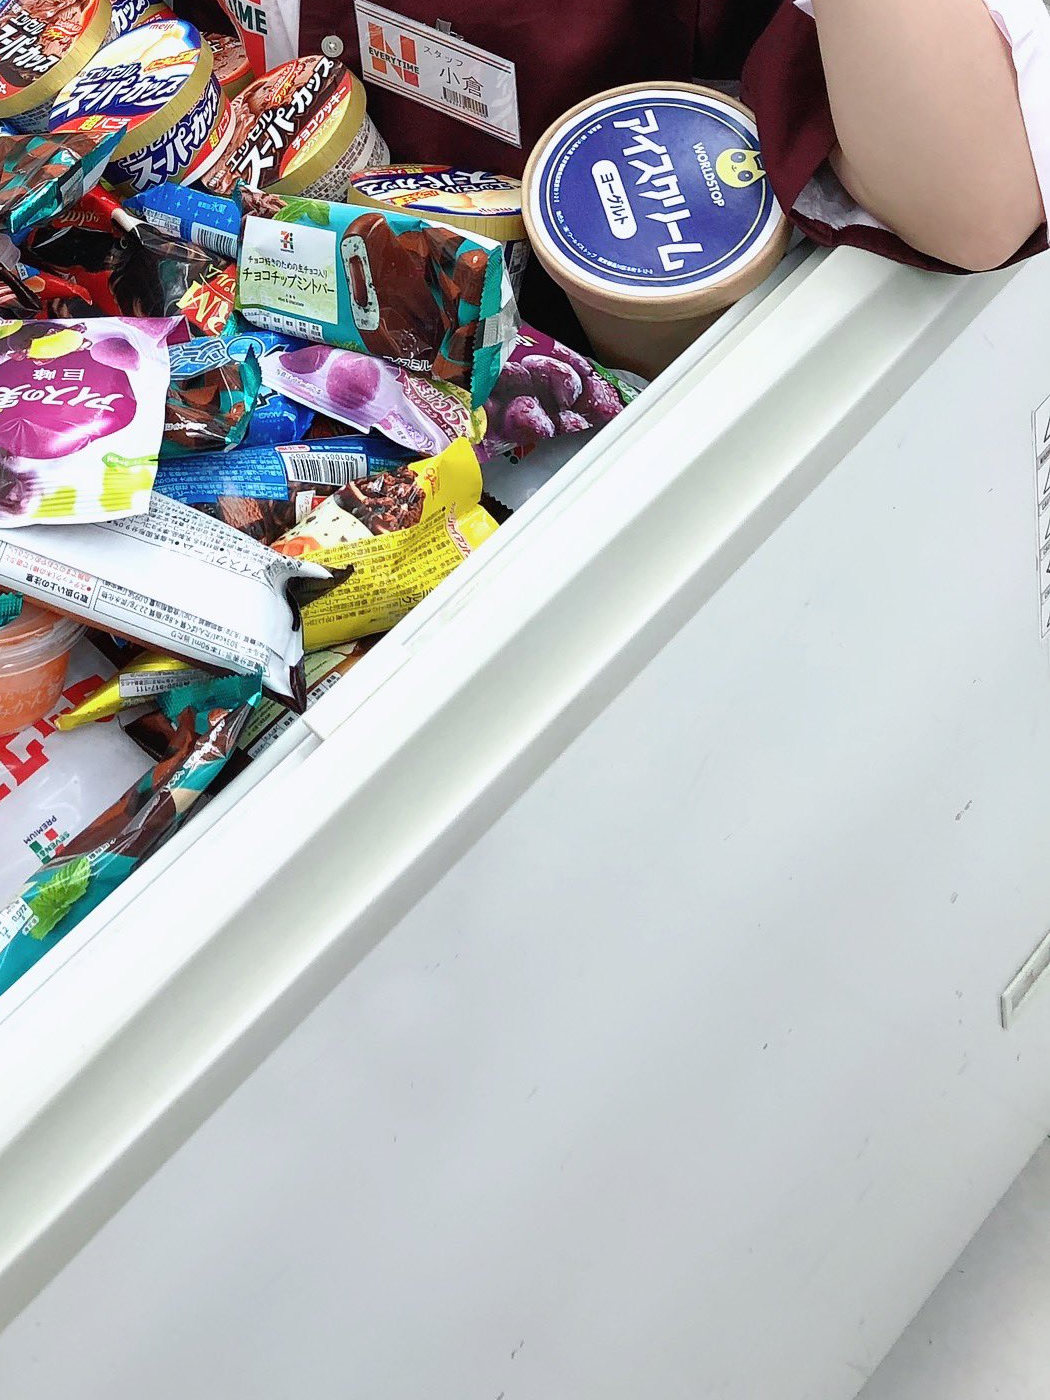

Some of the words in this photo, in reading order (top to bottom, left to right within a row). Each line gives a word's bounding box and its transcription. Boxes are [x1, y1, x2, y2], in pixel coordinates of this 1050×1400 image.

[13, 8, 47, 37] エッセル
[149, 22, 176, 32] meiji
[82, 61, 141, 81] エッセル
[368, 47, 420, 75] EVERYTIME
[423, 45, 464, 67] スタッフ
[50, 74, 188, 118] スーパーカップ
[439, 67, 485, 98] 小倉
[237, 56, 334, 190] スーパーカップ
[291, 86, 347, 151] チョコクッキー
[131, 84, 220, 192] スーパーカップ
[226, 109, 274, 171] エッセル
[361, 171, 498, 196] スーパーカップ
[612, 108, 704, 272] アイスクリーム
[692, 141, 726, 208] WORLDSTOP
[599, 171, 630, 226] ヨーグルト
[242, 267, 335, 295] チョコチップミントバー
[32, 368, 85, 381] 巨峰
[289, 452, 321, 460] 312005
[325, 452, 356, 461] 901005
[25, 572, 89, 604] 取り扱い上の注意
[23, 814, 58, 846] PREMIUM
